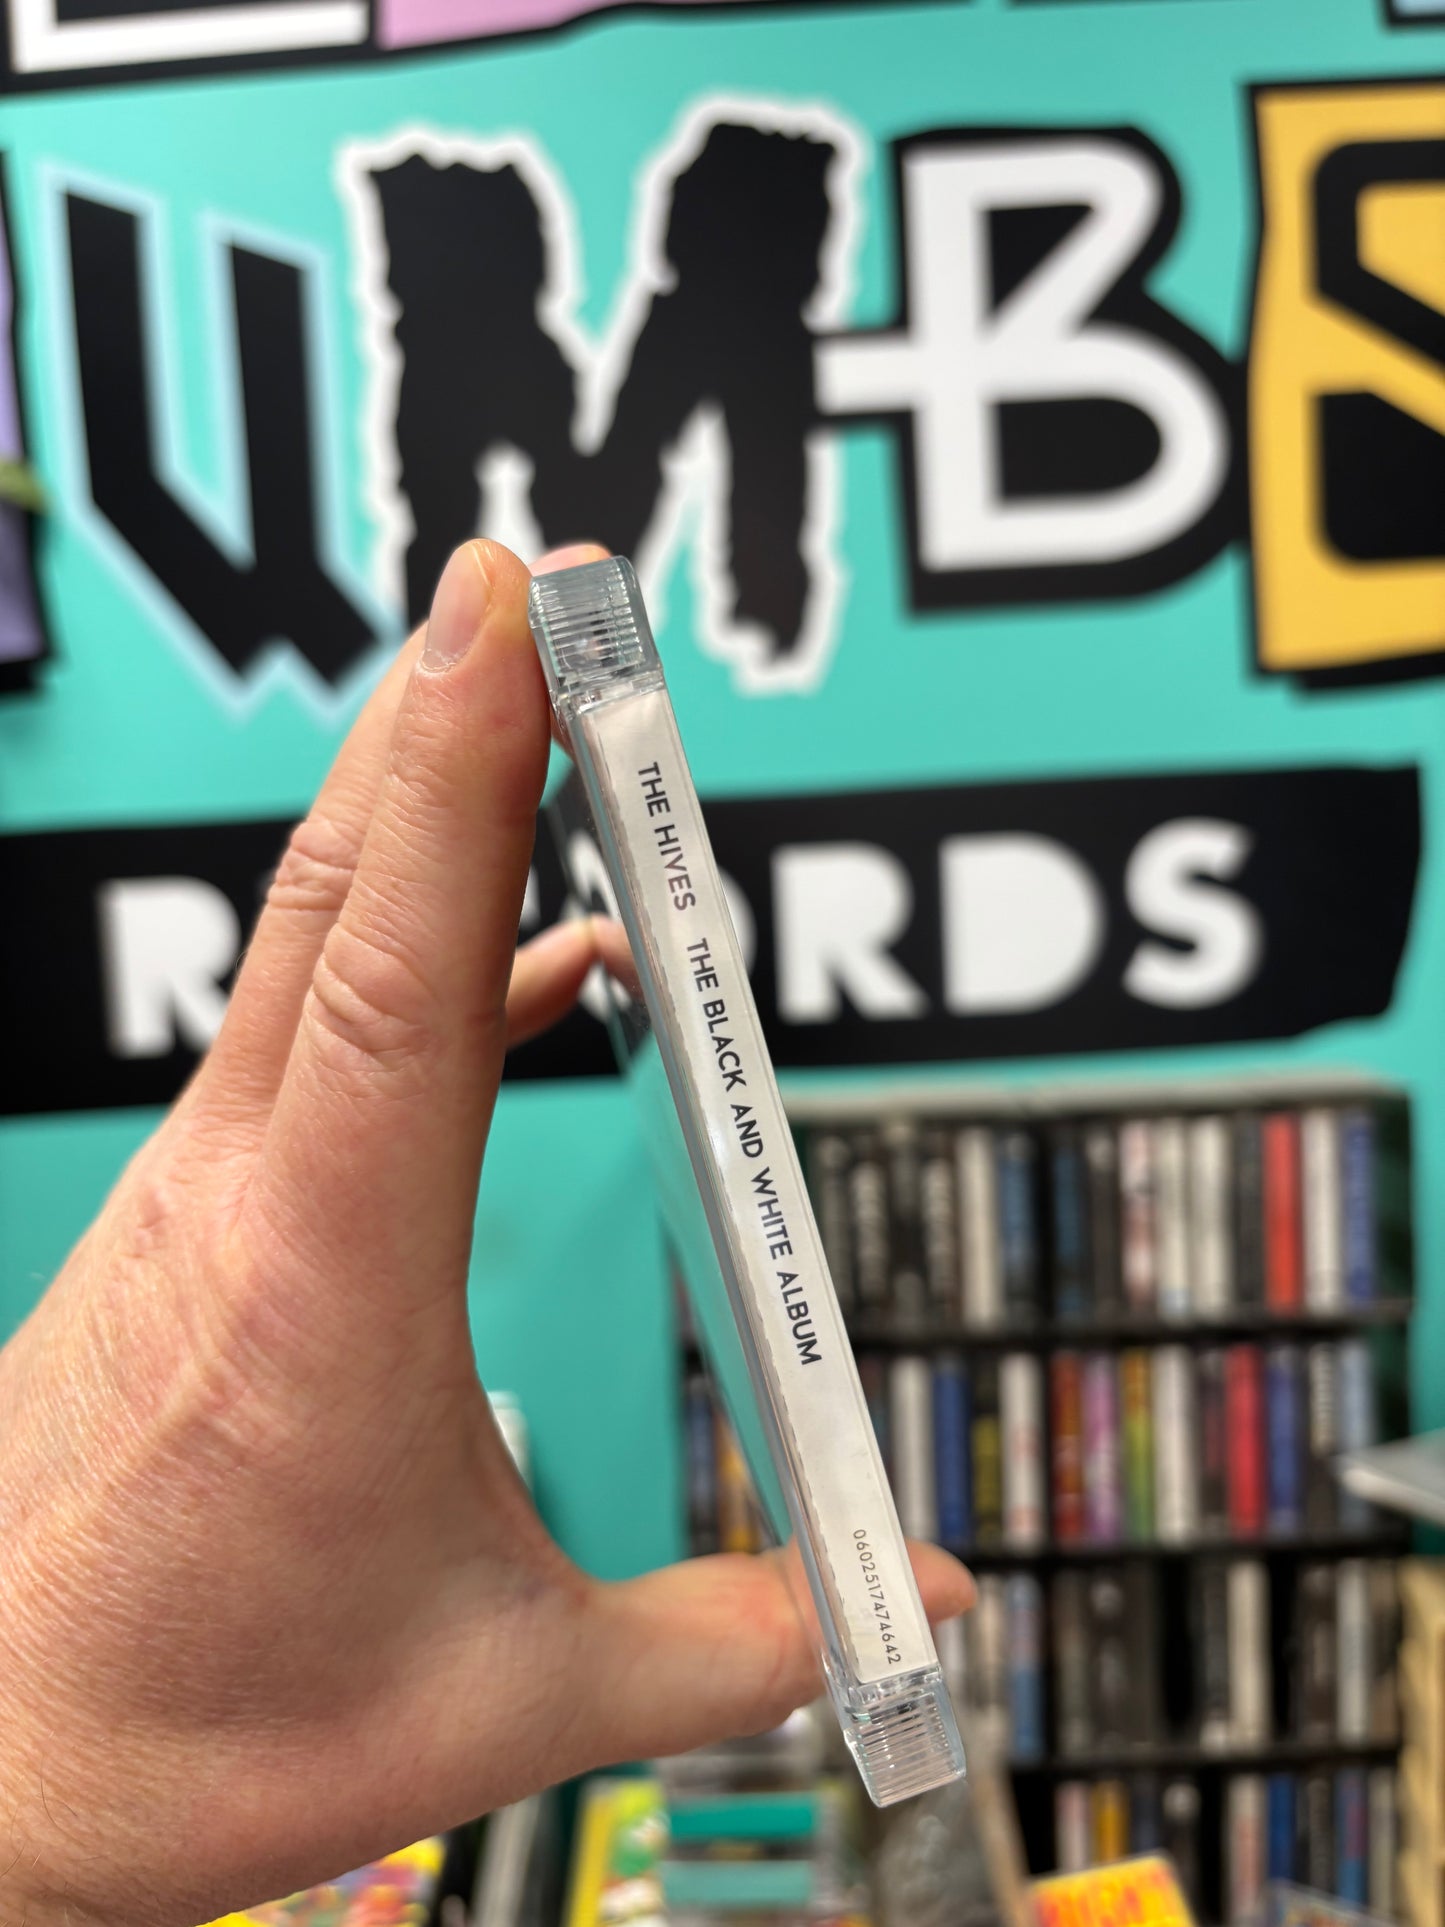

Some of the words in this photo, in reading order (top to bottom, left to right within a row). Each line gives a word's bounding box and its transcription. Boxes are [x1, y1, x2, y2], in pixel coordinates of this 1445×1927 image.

[637, 761, 672, 818] THE
[653, 823, 697, 912] HIVES
[686, 937, 720, 993] THE
[702, 998, 748, 1093] BLACK
[730, 1102, 765, 1159] AND
[750, 1166, 794, 1260] WHITE
[776, 1271, 823, 1366] ALBUM
[852, 1528, 902, 1665] 0602517474642
